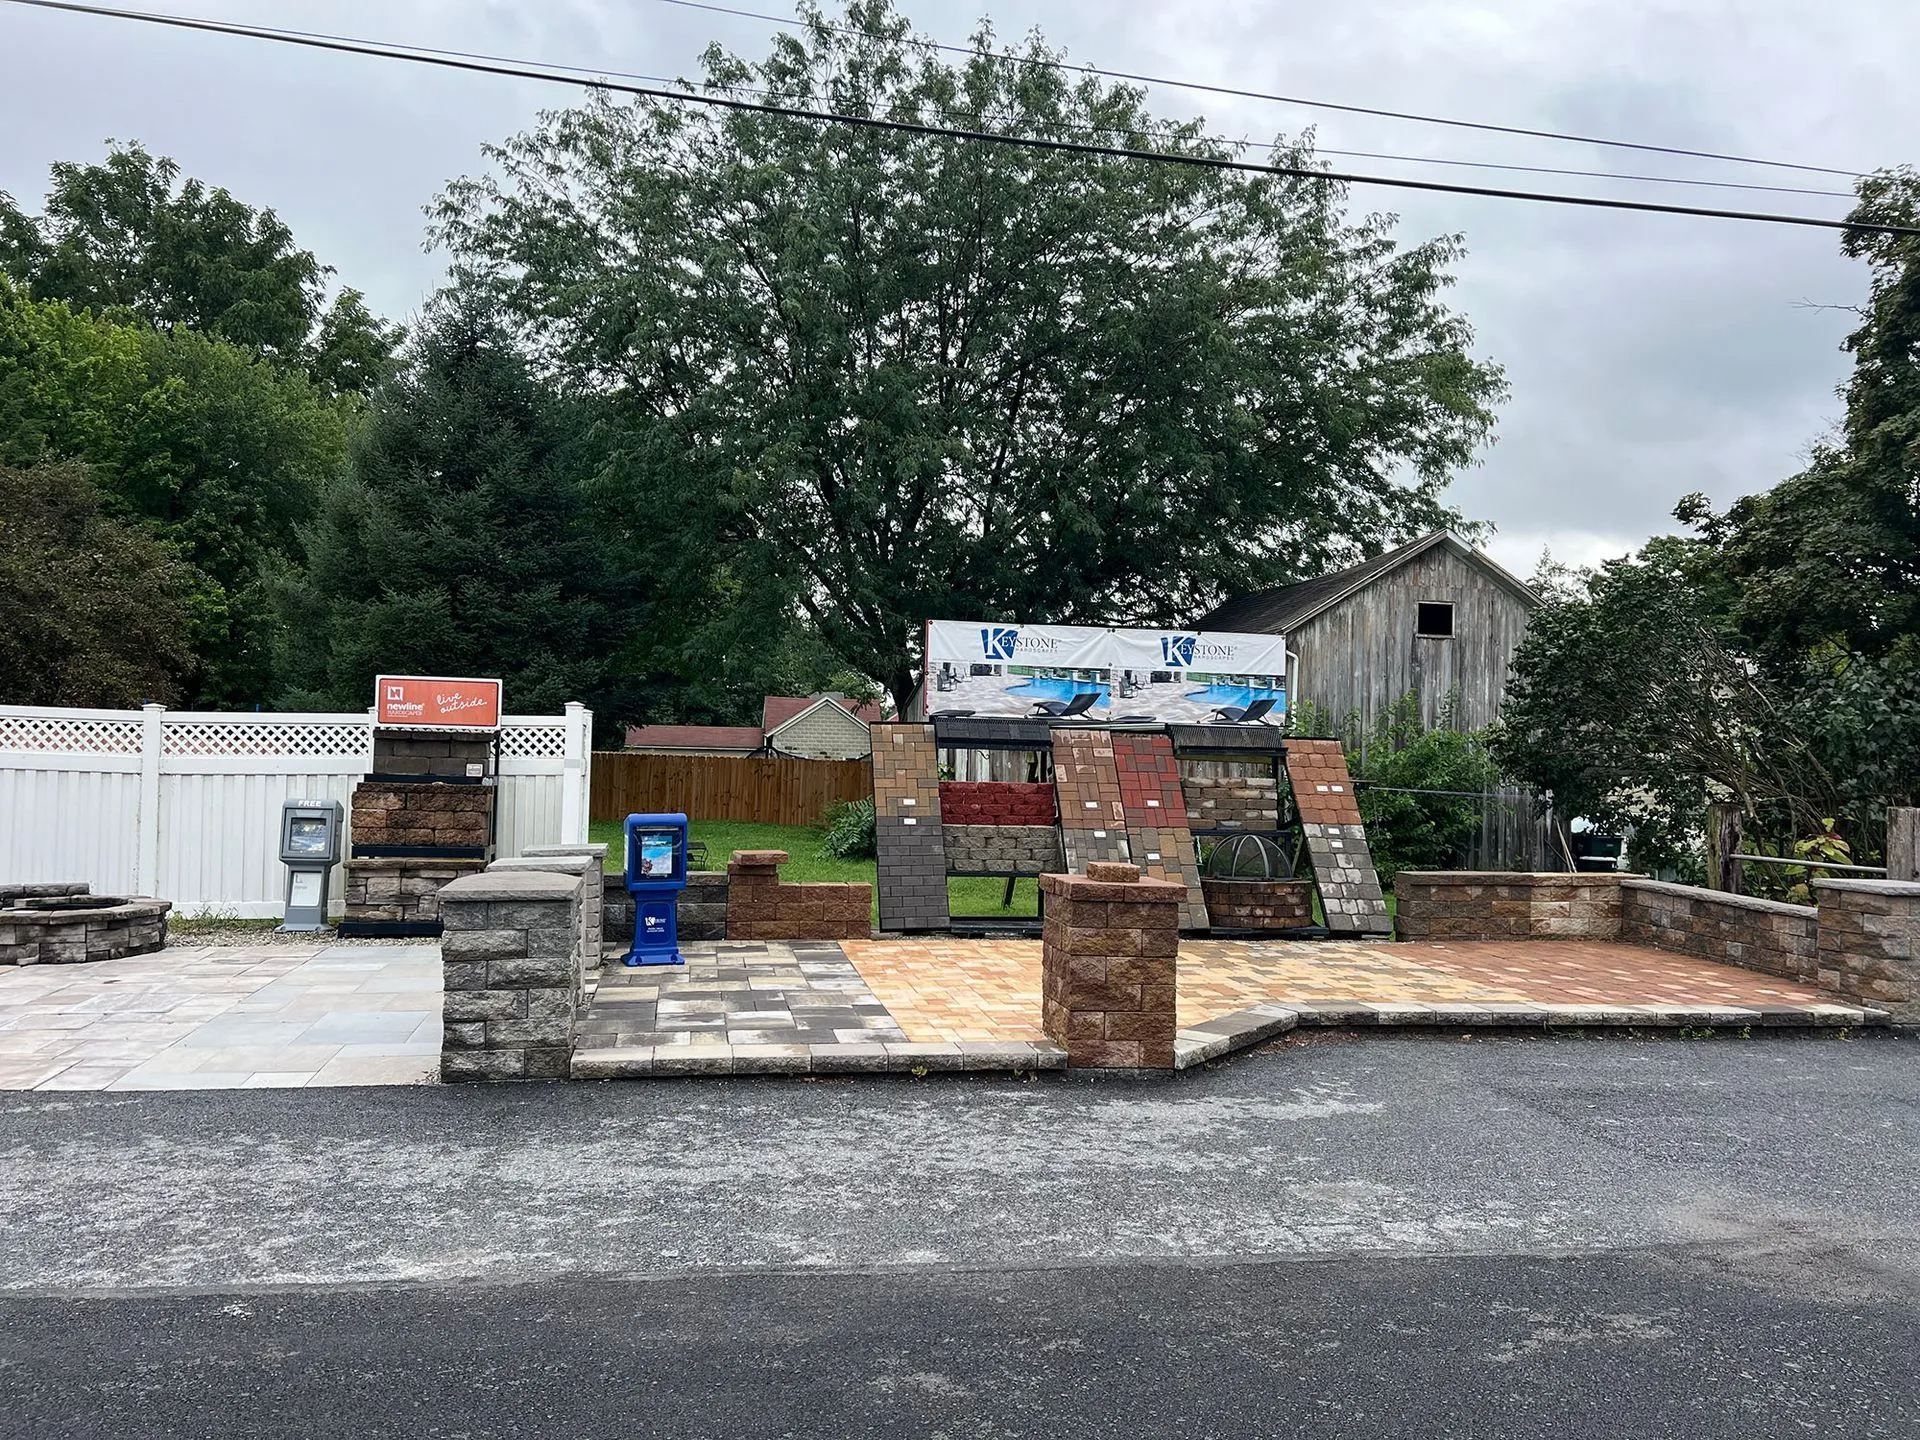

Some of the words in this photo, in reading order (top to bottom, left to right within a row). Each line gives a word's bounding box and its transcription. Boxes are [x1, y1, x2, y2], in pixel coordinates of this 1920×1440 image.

[981, 627, 1058, 660] KEYSTONE
[1160, 635, 1234, 667] KEYSTONE
[387, 702, 424, 711] newline
[436, 692, 462, 705] live
